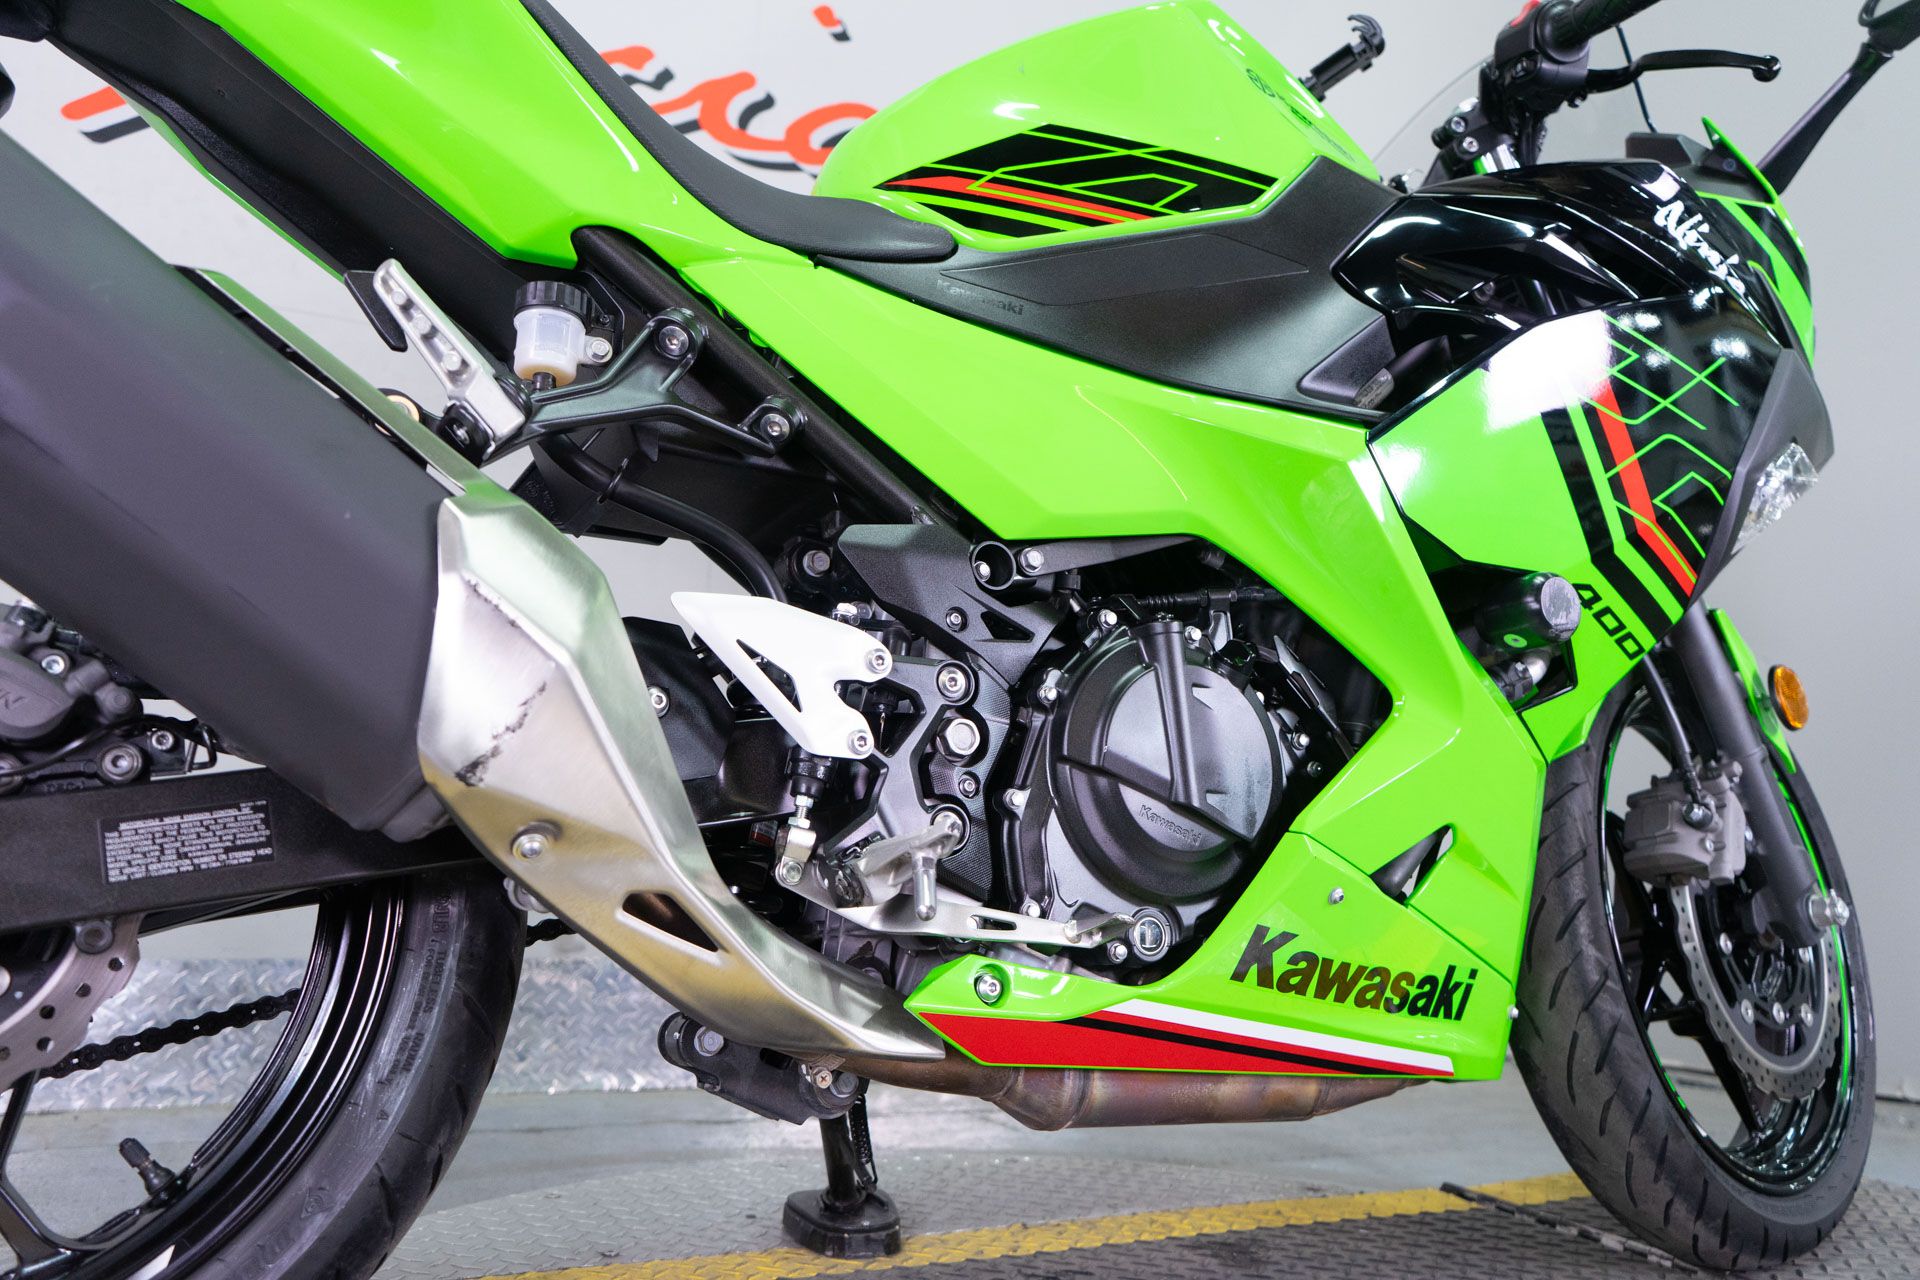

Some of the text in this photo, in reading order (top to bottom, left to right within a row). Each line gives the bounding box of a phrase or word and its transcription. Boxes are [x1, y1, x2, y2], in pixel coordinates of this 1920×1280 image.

[1571, 583, 1646, 661] 400
[1139, 804, 1203, 847] Kawasaki
[1229, 923, 1479, 1022] Kawasaki
